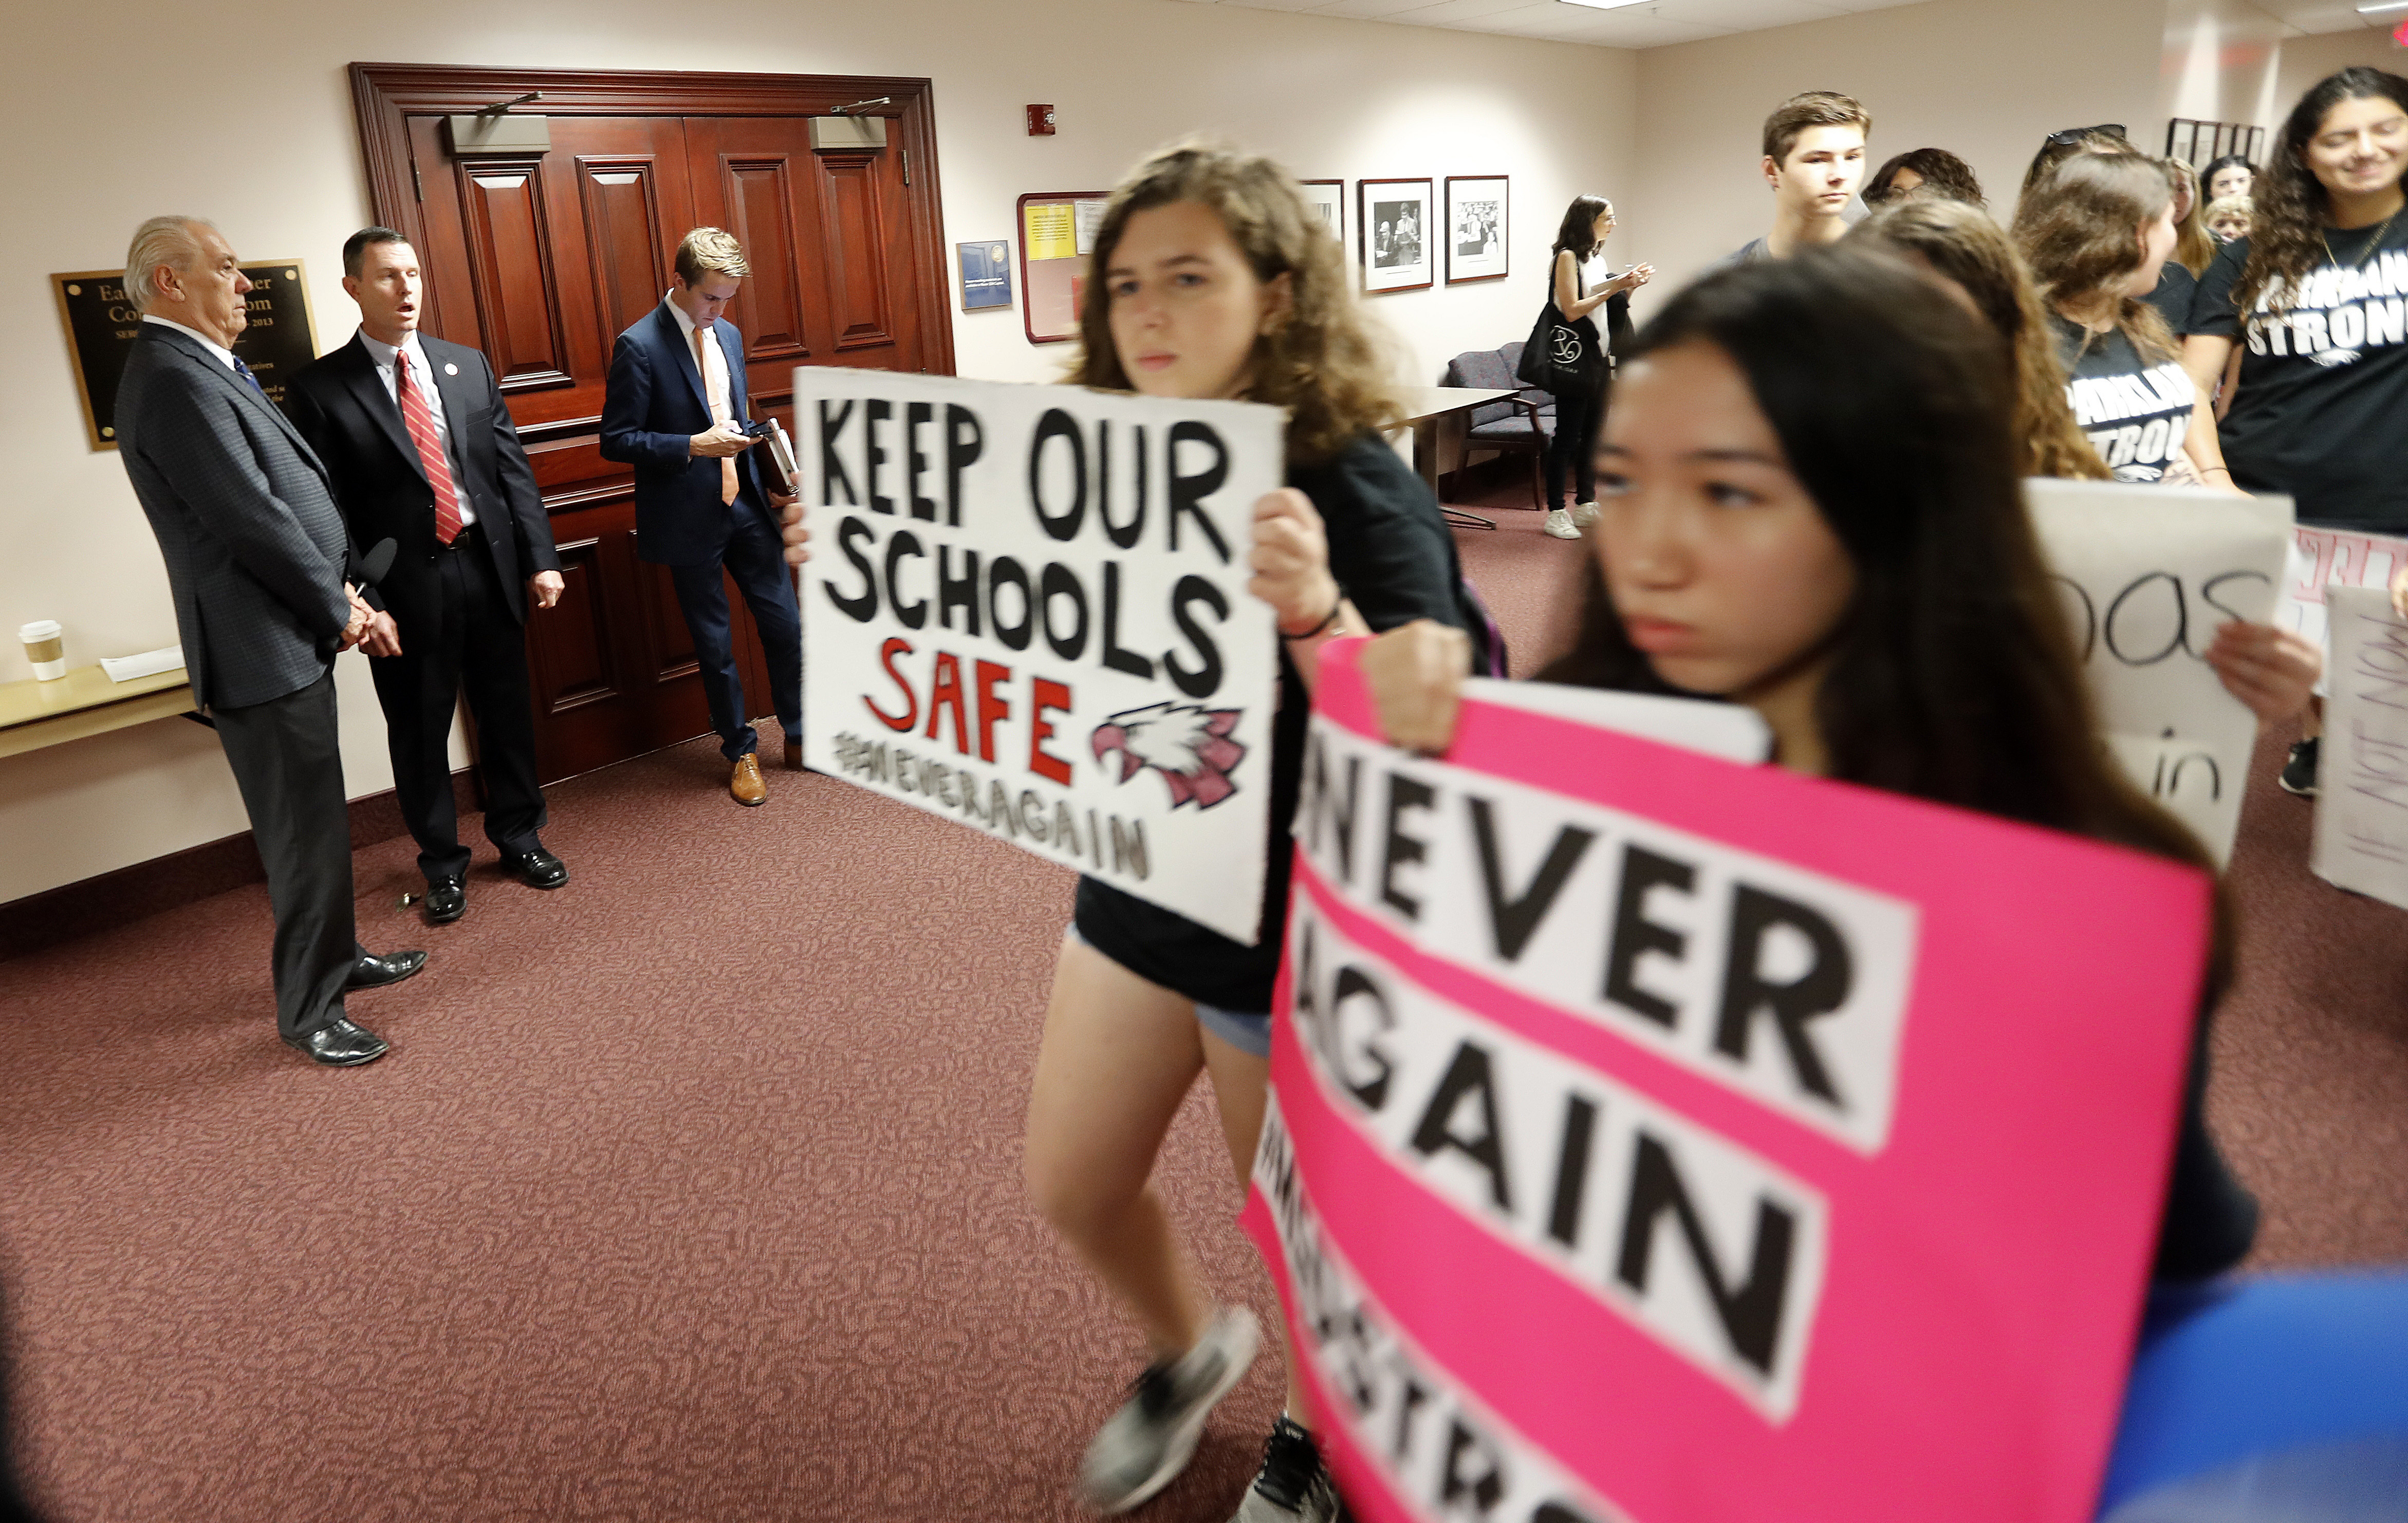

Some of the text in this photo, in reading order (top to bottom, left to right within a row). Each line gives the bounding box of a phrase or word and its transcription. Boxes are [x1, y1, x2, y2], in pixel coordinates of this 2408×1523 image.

[2246, 297, 2408, 357] STRON
[819, 398, 1231, 565] KEEP OUR
[823, 514, 1231, 699] SCHOOLS
[861, 636, 1075, 787] SAFE
[1305, 729, 1859, 1114] NEVER
[1295, 916, 1800, 1386] AGAIN
